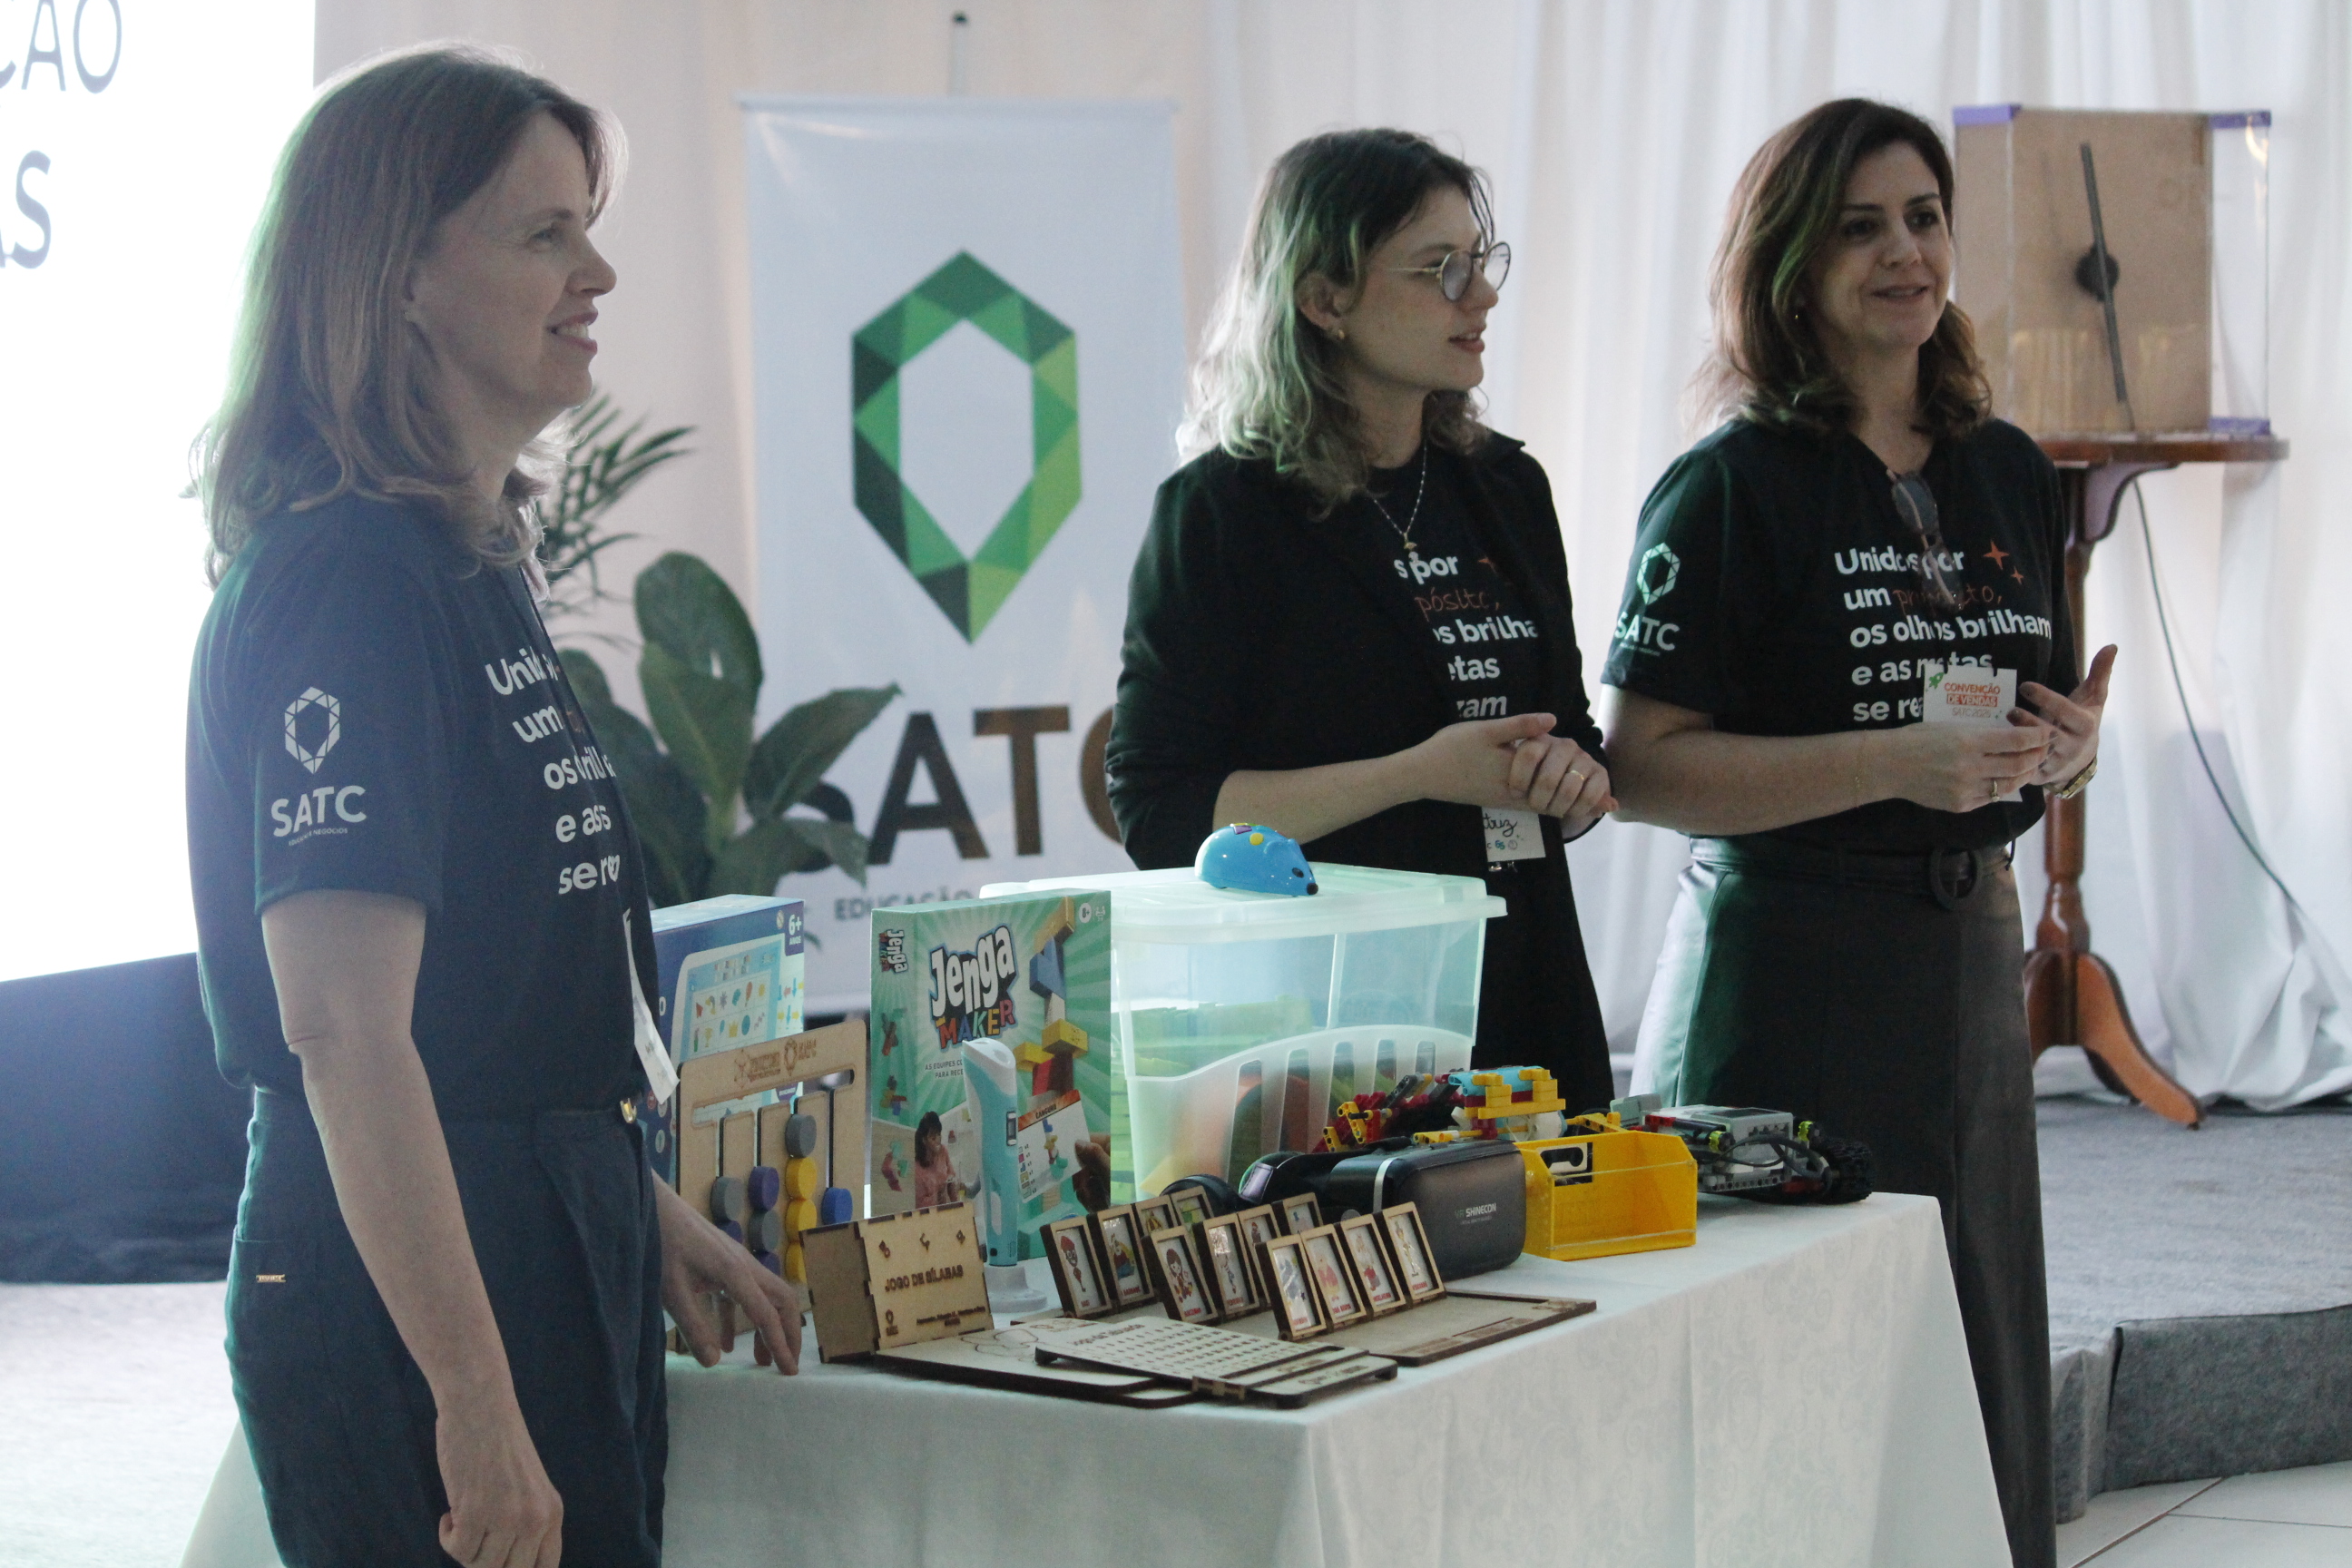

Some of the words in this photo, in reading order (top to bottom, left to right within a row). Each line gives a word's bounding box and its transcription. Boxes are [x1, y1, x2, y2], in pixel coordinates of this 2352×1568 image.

[0, 150, 52, 269] S
[1410, 555, 1458, 585] por
[1844, 587, 1891, 611] um
[1614, 611, 1681, 652] SATC
[1850, 623, 1887, 648] os
[1447, 655, 1501, 681] tas
[1851, 665, 1873, 686] e
[1880, 660, 1912, 682] as
[1944, 682, 2001, 695] CONVENÇÃO
[1947, 694, 1959, 704] DE
[1961, 695, 1996, 707] VENDAS
[512, 705, 564, 742] um
[1853, 701, 1890, 721] se
[544, 758, 578, 789] os
[270, 785, 368, 837] SATC
[555, 814, 577, 843] e
[558, 862, 599, 895] se
[788, 914, 802, 936] 6+
[887, 929, 908, 973] Jenga
[931, 926, 1016, 1017] Jenga
[937, 999, 1016, 1050] MAKER
[1465, 1203, 1497, 1218] SHINECON
[885, 1276, 910, 1292] JOGO
[911, 1272, 925, 1287] DE
